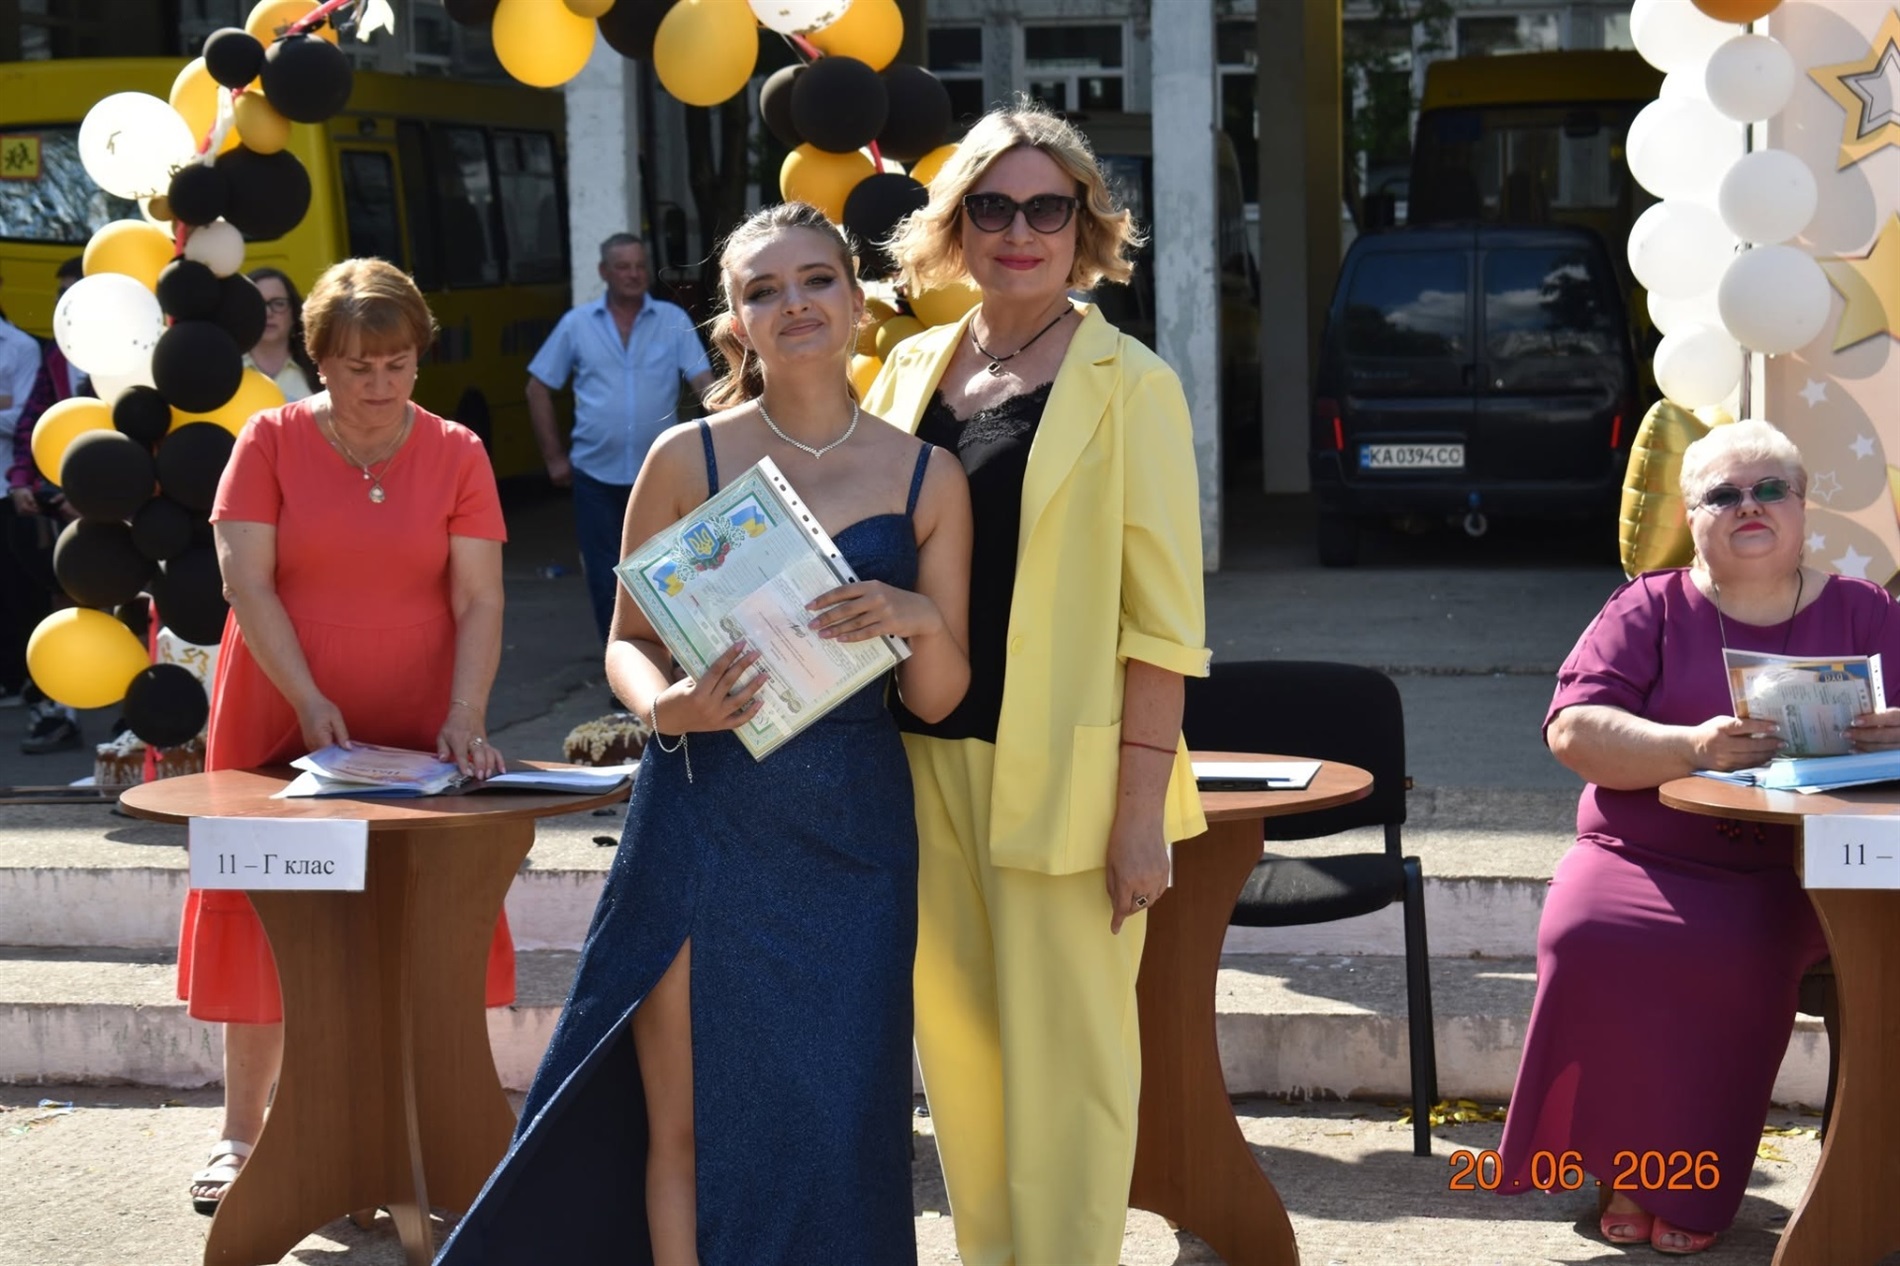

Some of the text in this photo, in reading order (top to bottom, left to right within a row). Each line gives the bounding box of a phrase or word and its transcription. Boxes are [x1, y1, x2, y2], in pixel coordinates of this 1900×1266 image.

[218, 854, 236, 874] 11
[263, 854, 278, 874] Г
[284, 859, 335, 875] клас
[1843, 844, 1866, 865] 11
